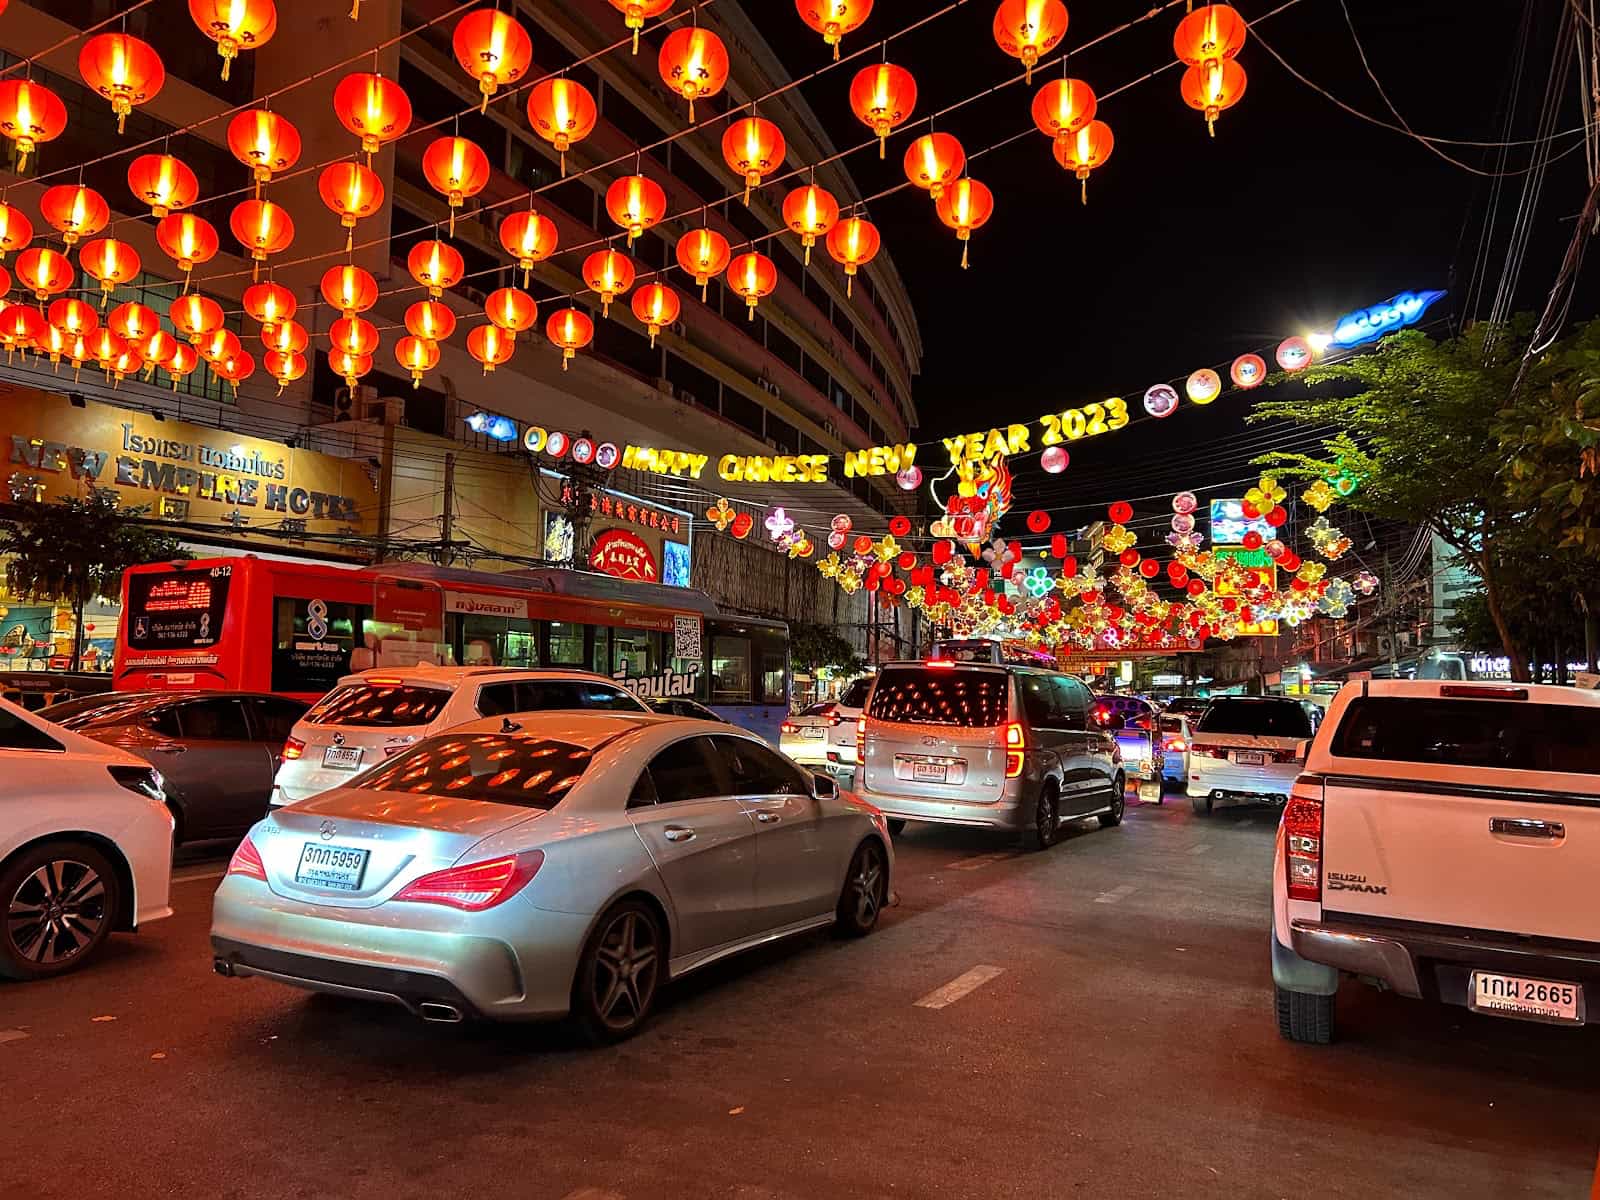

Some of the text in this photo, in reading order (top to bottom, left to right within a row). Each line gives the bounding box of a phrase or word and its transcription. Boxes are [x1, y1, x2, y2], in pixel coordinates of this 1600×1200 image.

[621, 397, 1129, 483] HAPPY CHINESE NEW YEAR 2023
[9, 433, 362, 522] NEW EMPIRE HOTEL
[209, 566, 232, 578] 40-12
[331, 850, 362, 870] 5959
[1327, 872, 1367, 883] ISUZU
[1327, 880, 1388, 895] D-MAX
[1523, 982, 1574, 1006] 2665
